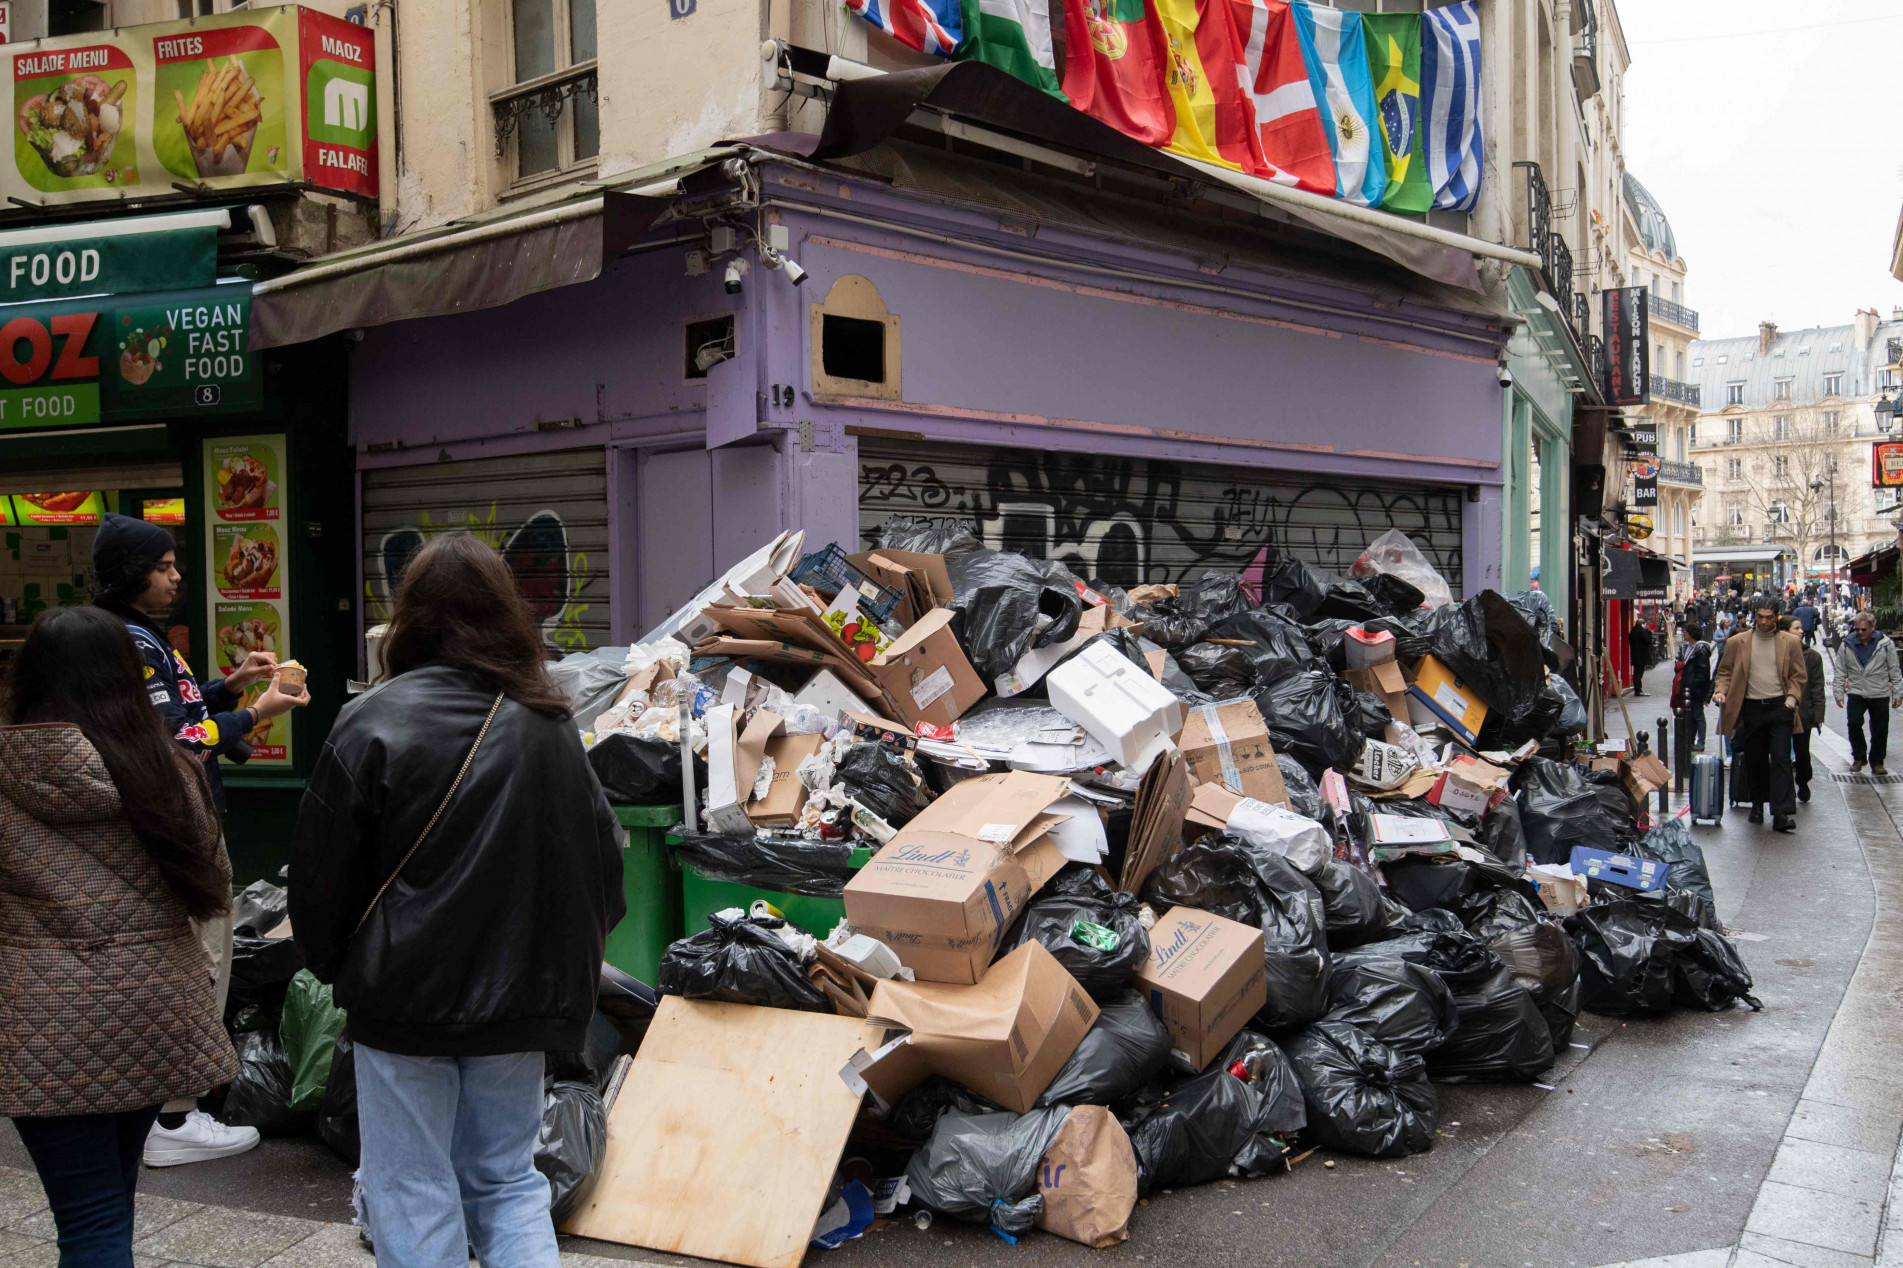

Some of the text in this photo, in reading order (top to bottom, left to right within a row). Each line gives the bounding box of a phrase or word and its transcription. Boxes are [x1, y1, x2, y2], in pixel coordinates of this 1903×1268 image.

[157, 37, 203, 60] FRITES
[321, 35, 363, 63] MAOZ
[17, 49, 109, 76] SALADE MENU
[318, 149, 369, 177] FALAFEL
[10, 249, 100, 289] FOOD
[166, 303, 242, 331] VEGAN
[188, 329, 243, 355] FAST
[1611, 291, 1621, 396] RESTAURANT
[1630, 289, 1641, 395] MAISON BLANCHE
[185, 355, 244, 380] FOOD
[22, 395, 75, 418] FOOD
[202, 387, 213, 402] 8
[771, 383, 796, 408] 19
[1636, 487, 1656, 499] BAR
[177, 679, 203, 705] Re
[1372, 750, 1382, 780] Locker
[886, 844, 957, 864] Lindt
[904, 867, 967, 881] CHOCOLATIER
[893, 932, 924, 946] Lindt
[1148, 928, 1190, 970] Lindt
[1184, 926, 1221, 962] CHOCOLATIER
